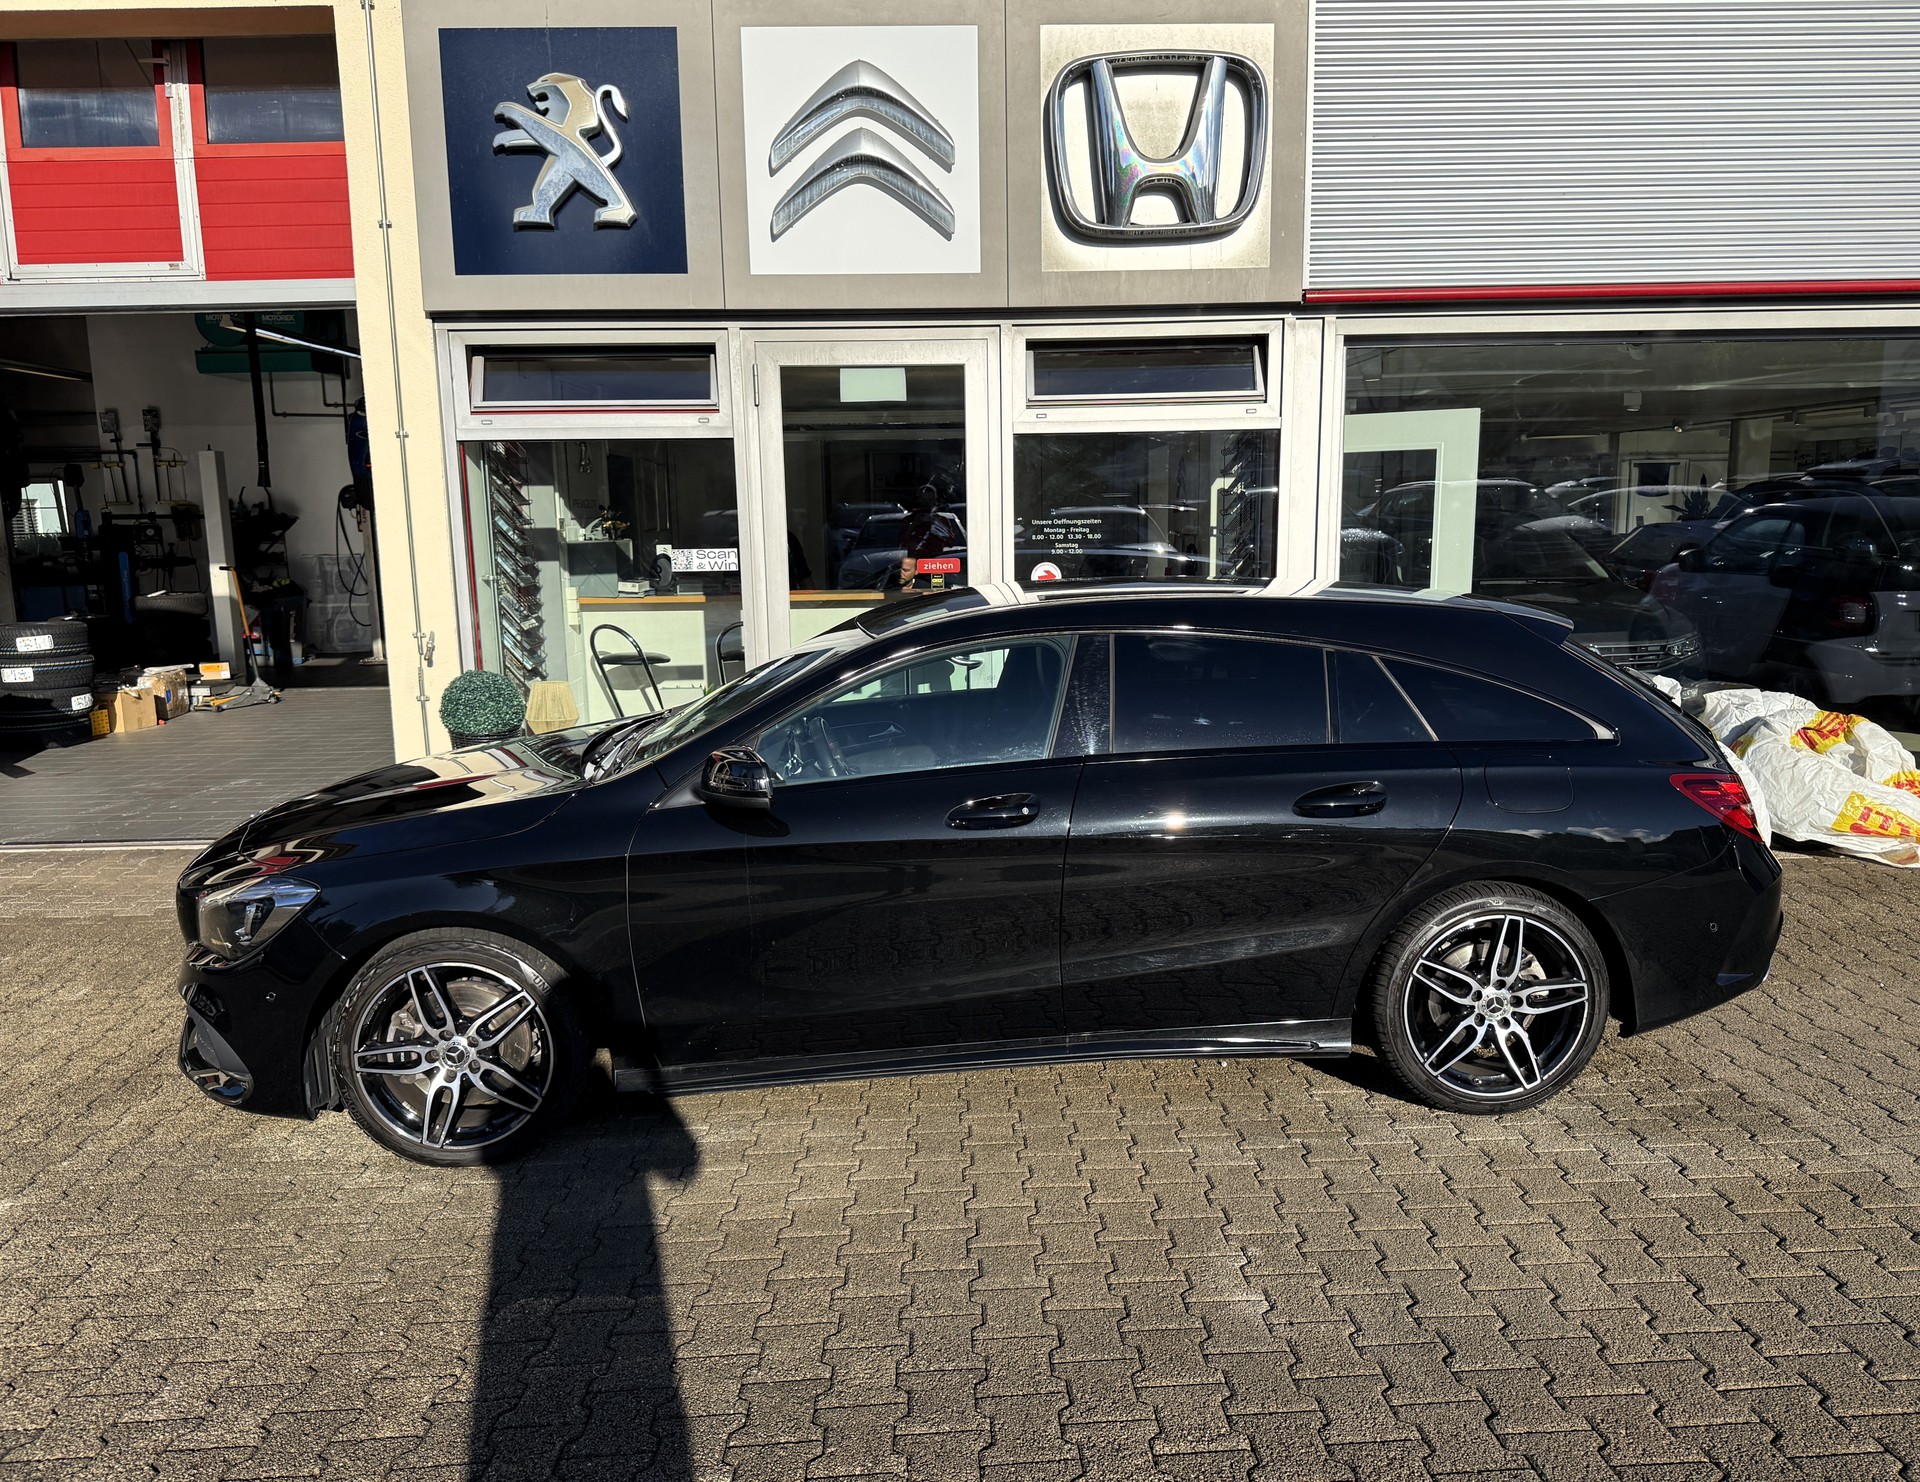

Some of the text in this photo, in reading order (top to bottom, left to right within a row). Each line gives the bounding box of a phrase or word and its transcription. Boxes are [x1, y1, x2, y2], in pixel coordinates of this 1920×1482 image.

[696, 549, 738, 560] Scan
[696, 559, 738, 570] & Win
[923, 561, 954, 570] ziehen
